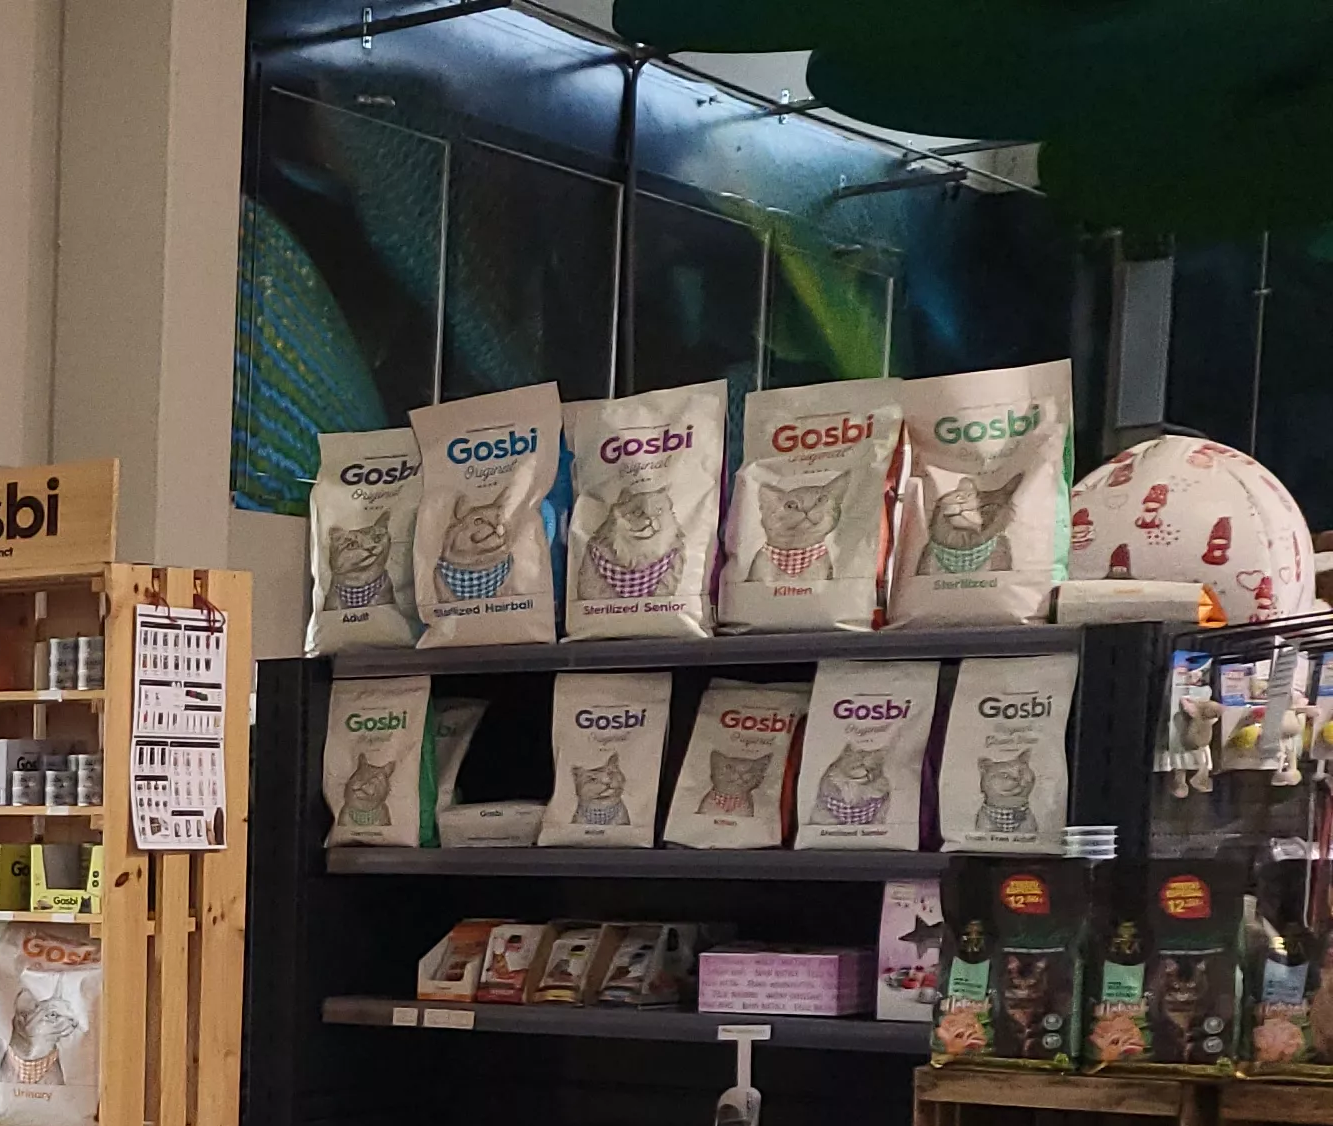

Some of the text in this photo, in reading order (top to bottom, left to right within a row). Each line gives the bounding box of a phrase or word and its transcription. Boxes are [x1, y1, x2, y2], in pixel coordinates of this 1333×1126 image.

[771, 414, 874, 453] Gosbi
[933, 404, 1040, 445] Gosbi
[447, 427, 538, 464] Gosbi
[600, 425, 694, 464] Gosbi
[773, 585, 813, 596] Kitten
[583, 601, 687, 616] Sterilized Senior
[833, 699, 912, 721] Gosbi
[978, 696, 1053, 719] Gosbi
[345, 711, 408, 733] Gosbi
[575, 709, 647, 731] Gosbi
[720, 709, 796, 734] Gosbi
[53, 896, 78, 906] Gosbi
[13, 1088, 53, 1100] Urinary
